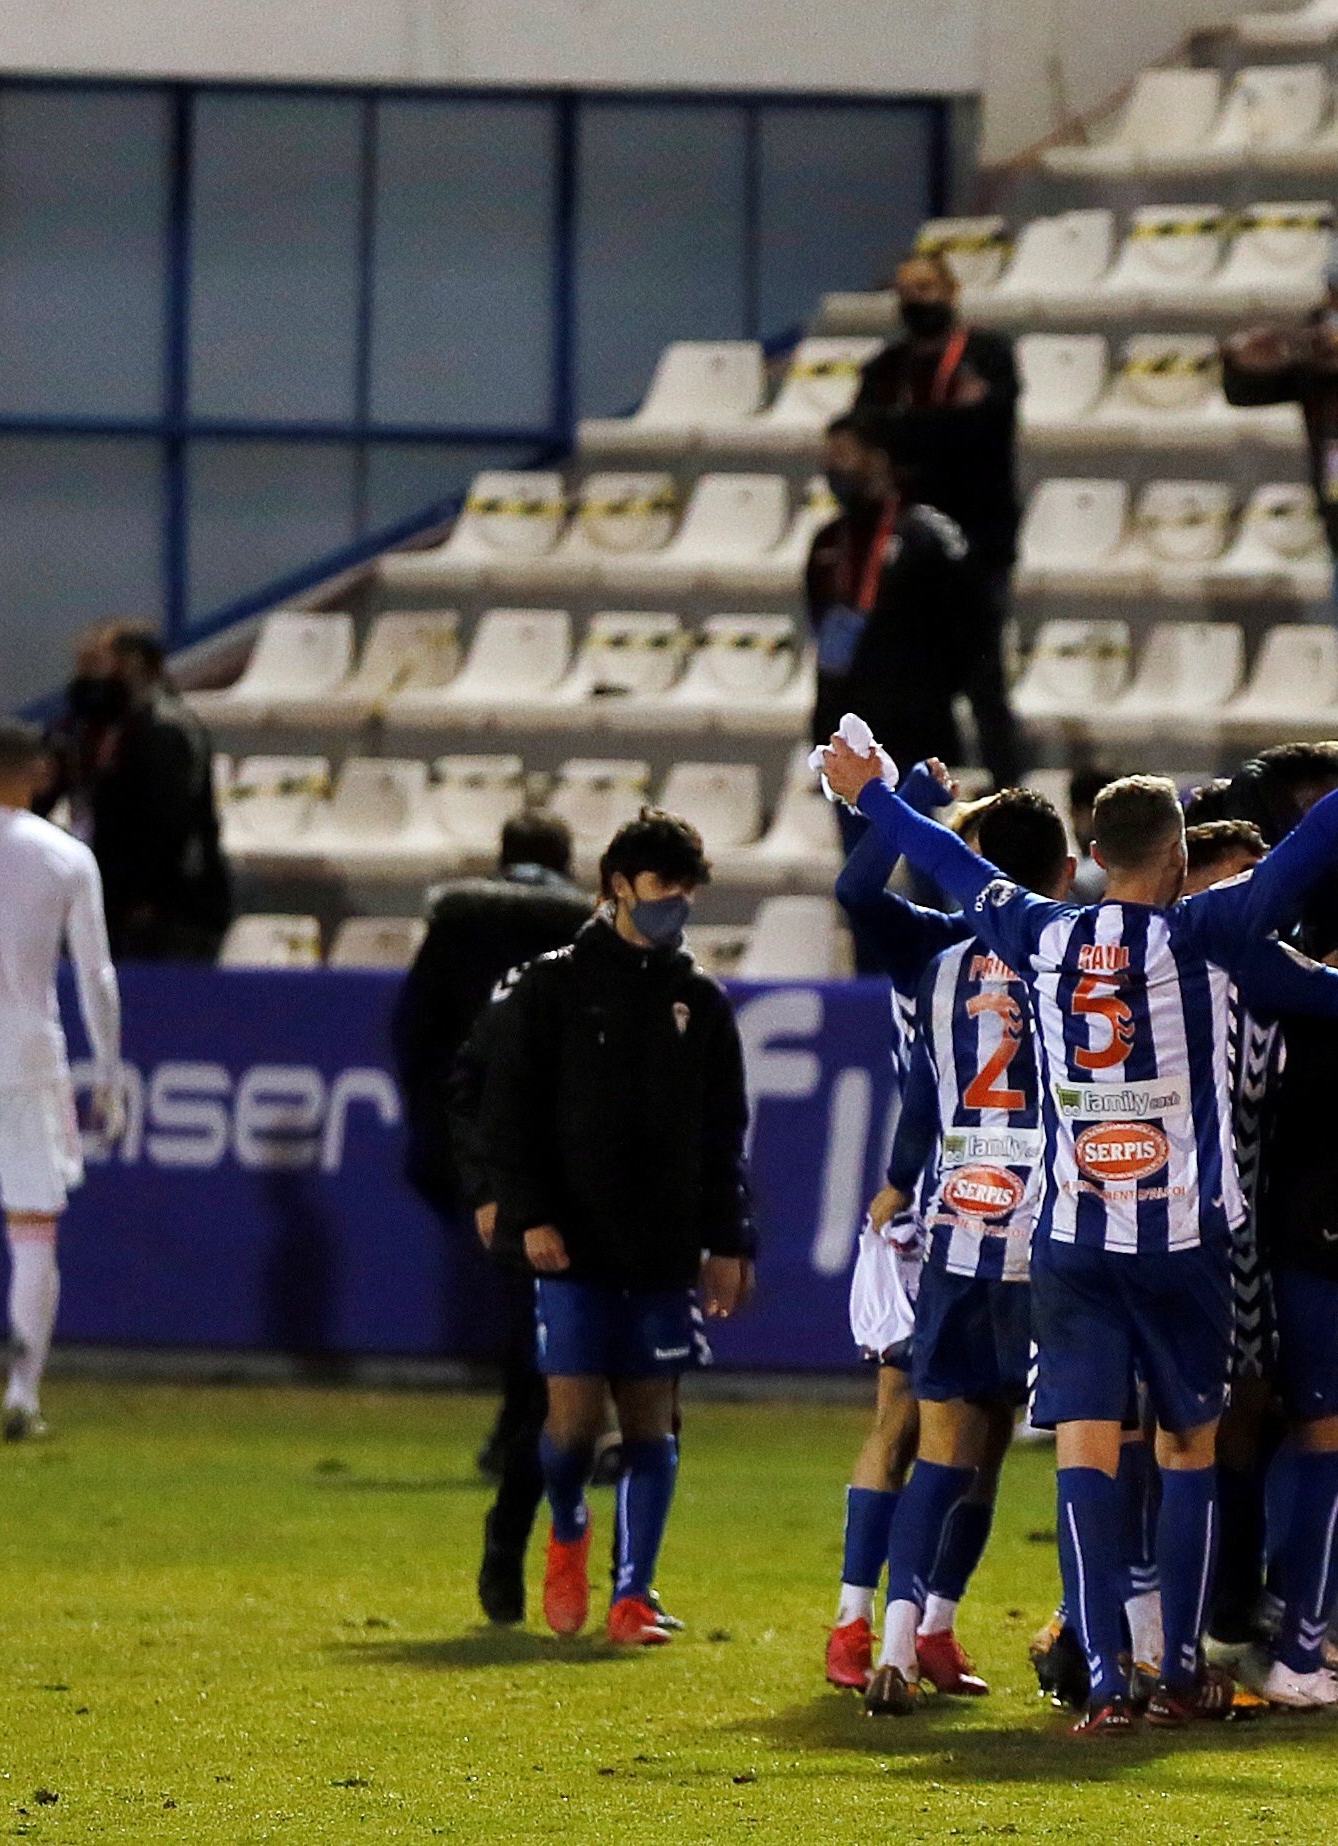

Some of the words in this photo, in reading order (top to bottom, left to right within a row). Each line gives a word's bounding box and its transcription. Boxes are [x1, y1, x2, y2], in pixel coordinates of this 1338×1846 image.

[1071, 971, 1137, 1070] 5
[963, 991, 1027, 1112] 2
[1084, 1090, 1149, 1115] family
[1084, 1140, 1157, 1163] SERPIS
[953, 1178, 1014, 1207] SERPIS
